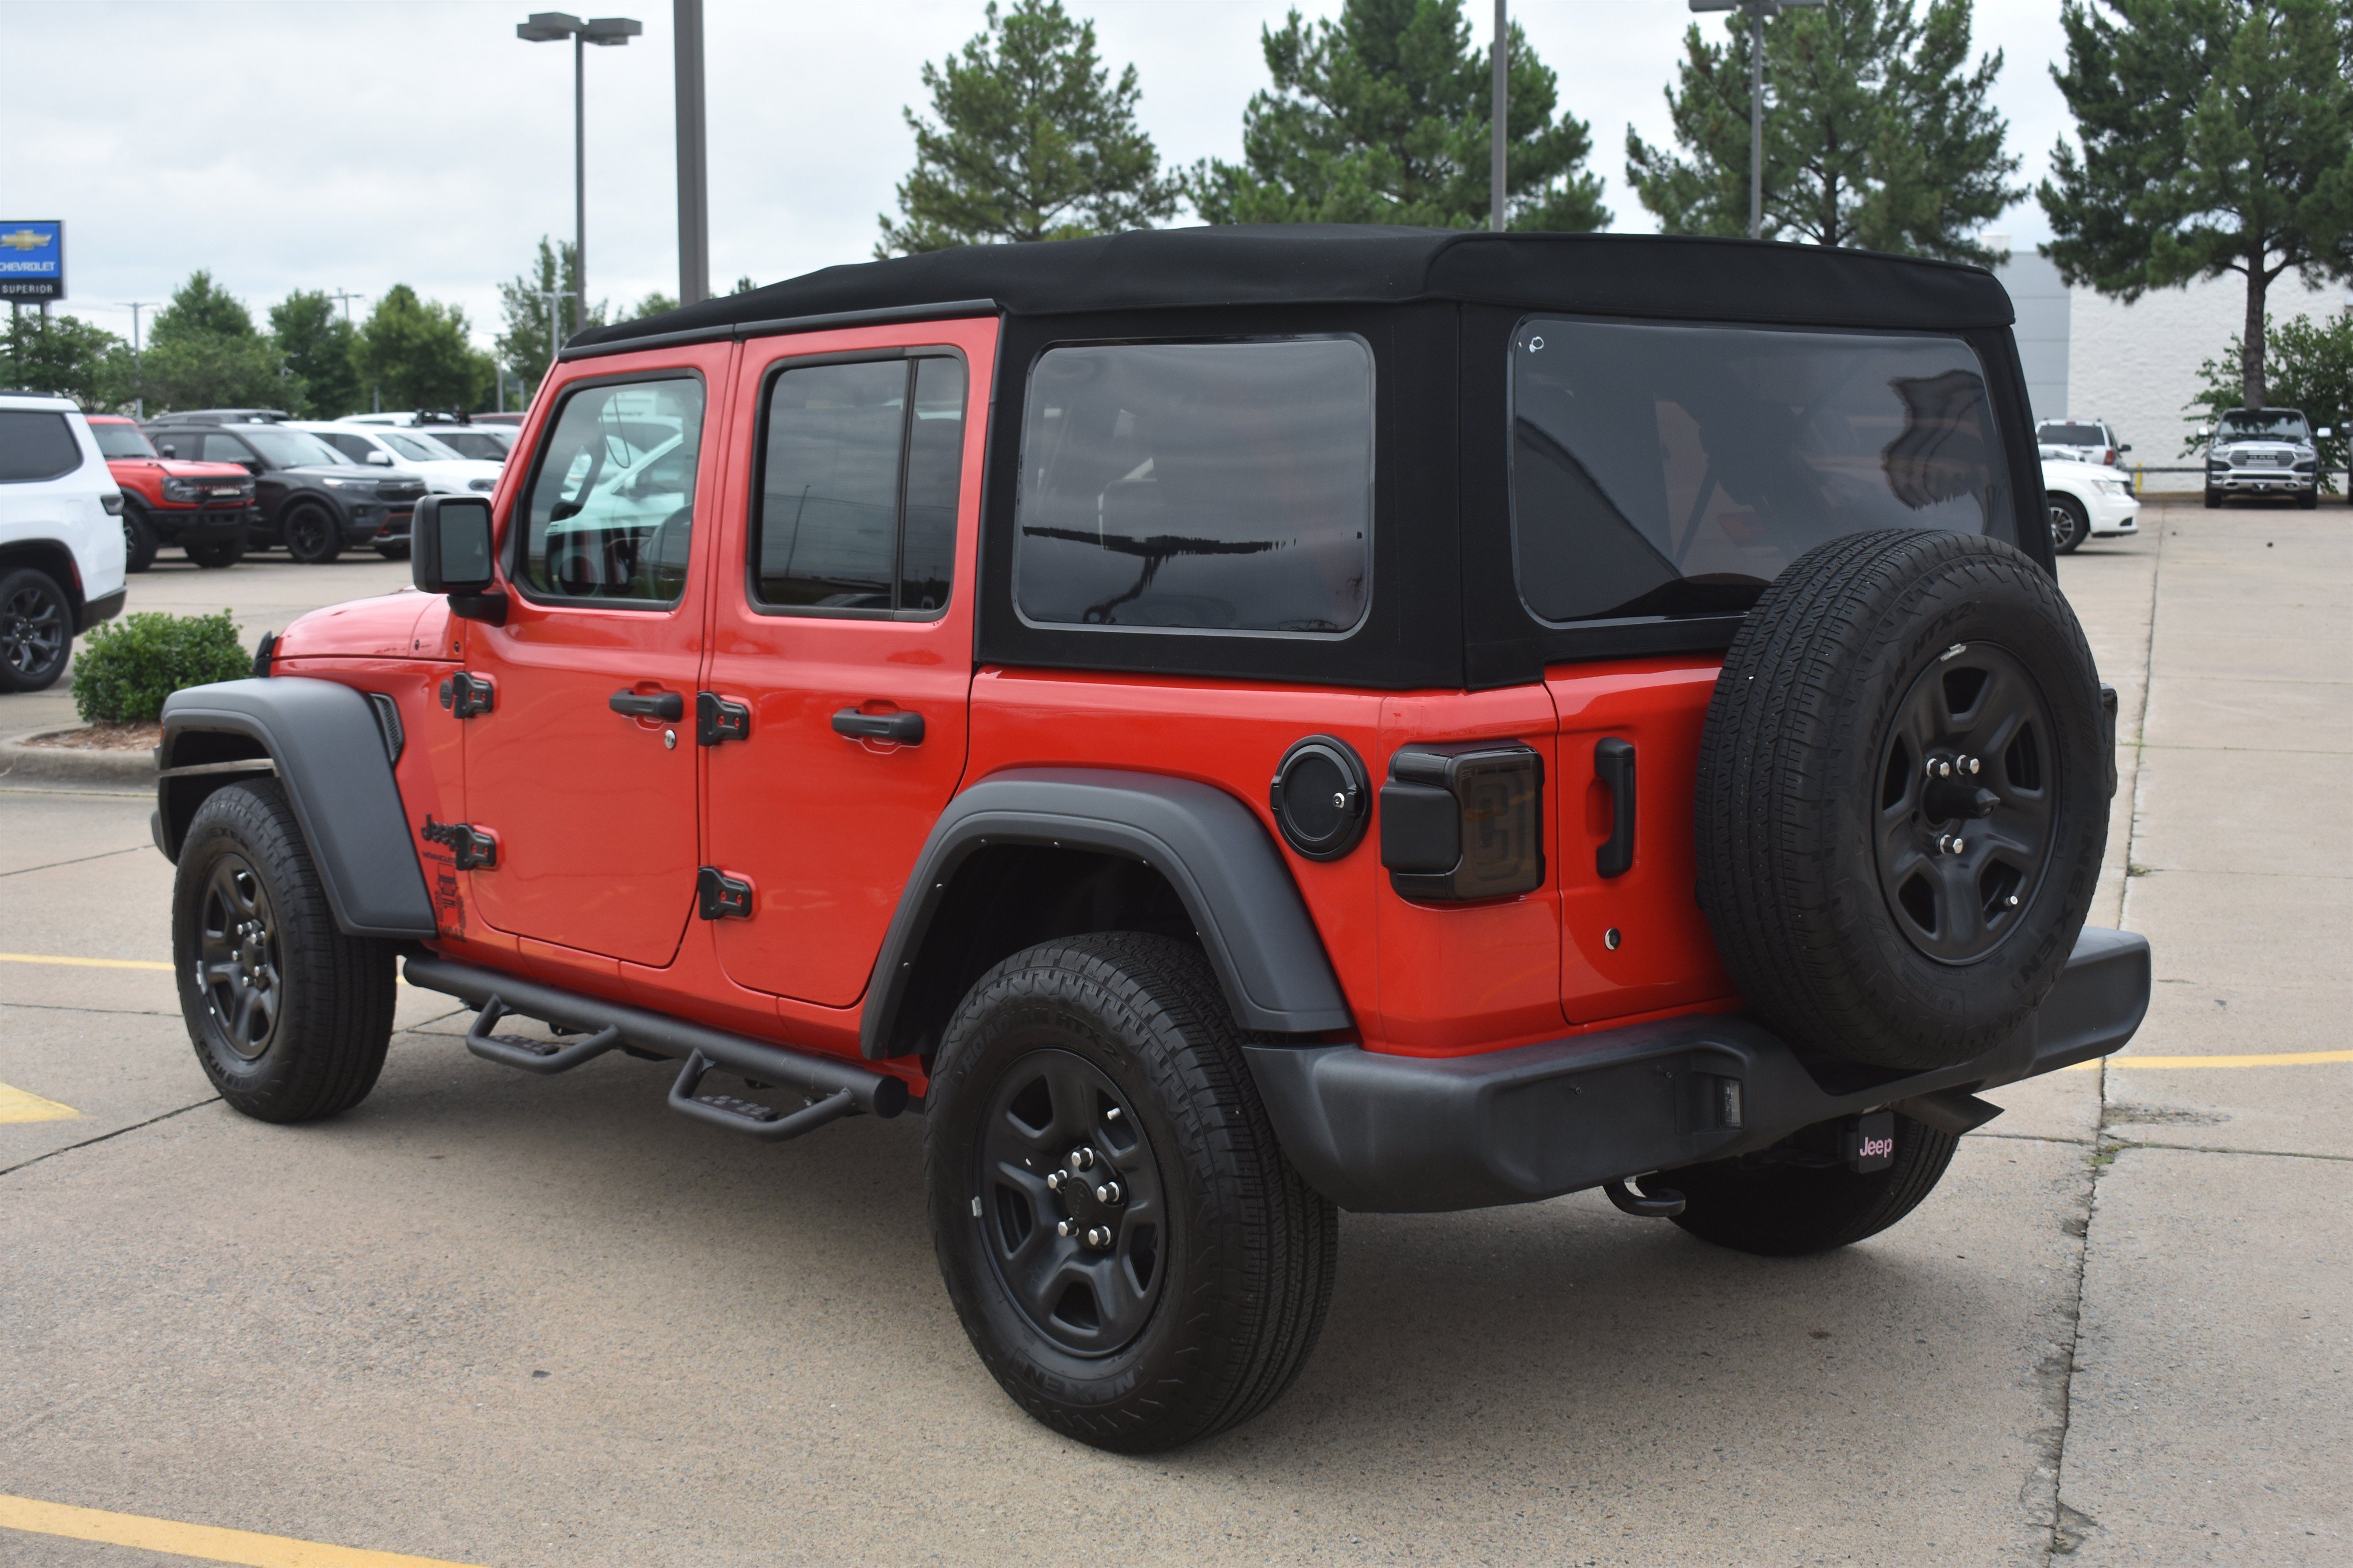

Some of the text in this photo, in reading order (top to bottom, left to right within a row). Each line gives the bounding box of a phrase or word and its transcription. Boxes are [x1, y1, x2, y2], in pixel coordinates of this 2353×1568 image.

[0, 261, 55, 272] CHEVROLET
[2, 284, 53, 294] SUPERIOR
[1860, 1137, 1892, 1158] Jeep
